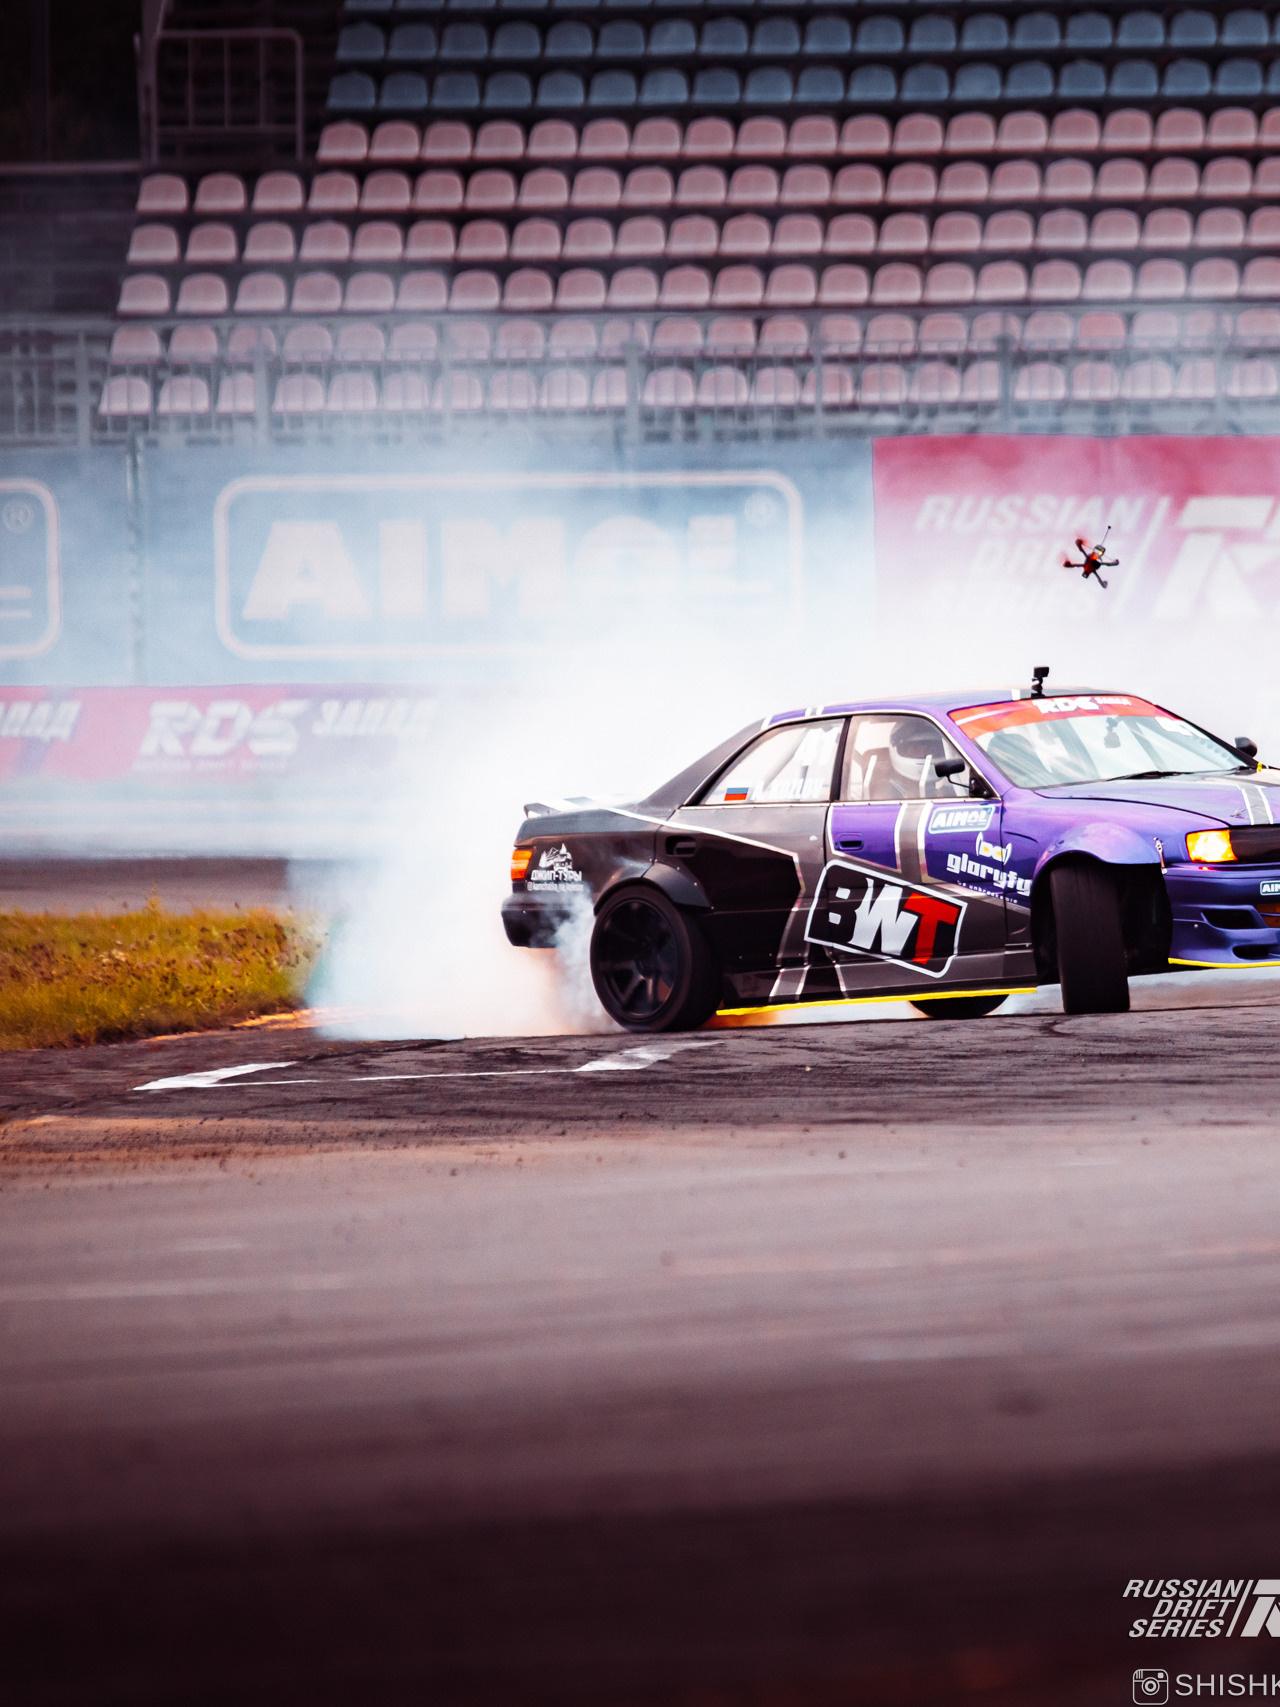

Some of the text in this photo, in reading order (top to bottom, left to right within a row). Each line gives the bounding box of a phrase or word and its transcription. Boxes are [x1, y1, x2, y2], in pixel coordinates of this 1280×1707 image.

[915, 494, 1144, 533] RUSSIAN
[242, 515, 778, 619] AIMOL
[0, 700, 82, 742] ПАД
[1032, 696, 1099, 713] RDS
[140, 701, 310, 757] RDS
[946, 853, 1032, 897] gloryfy
[822, 877, 959, 965] BWT
